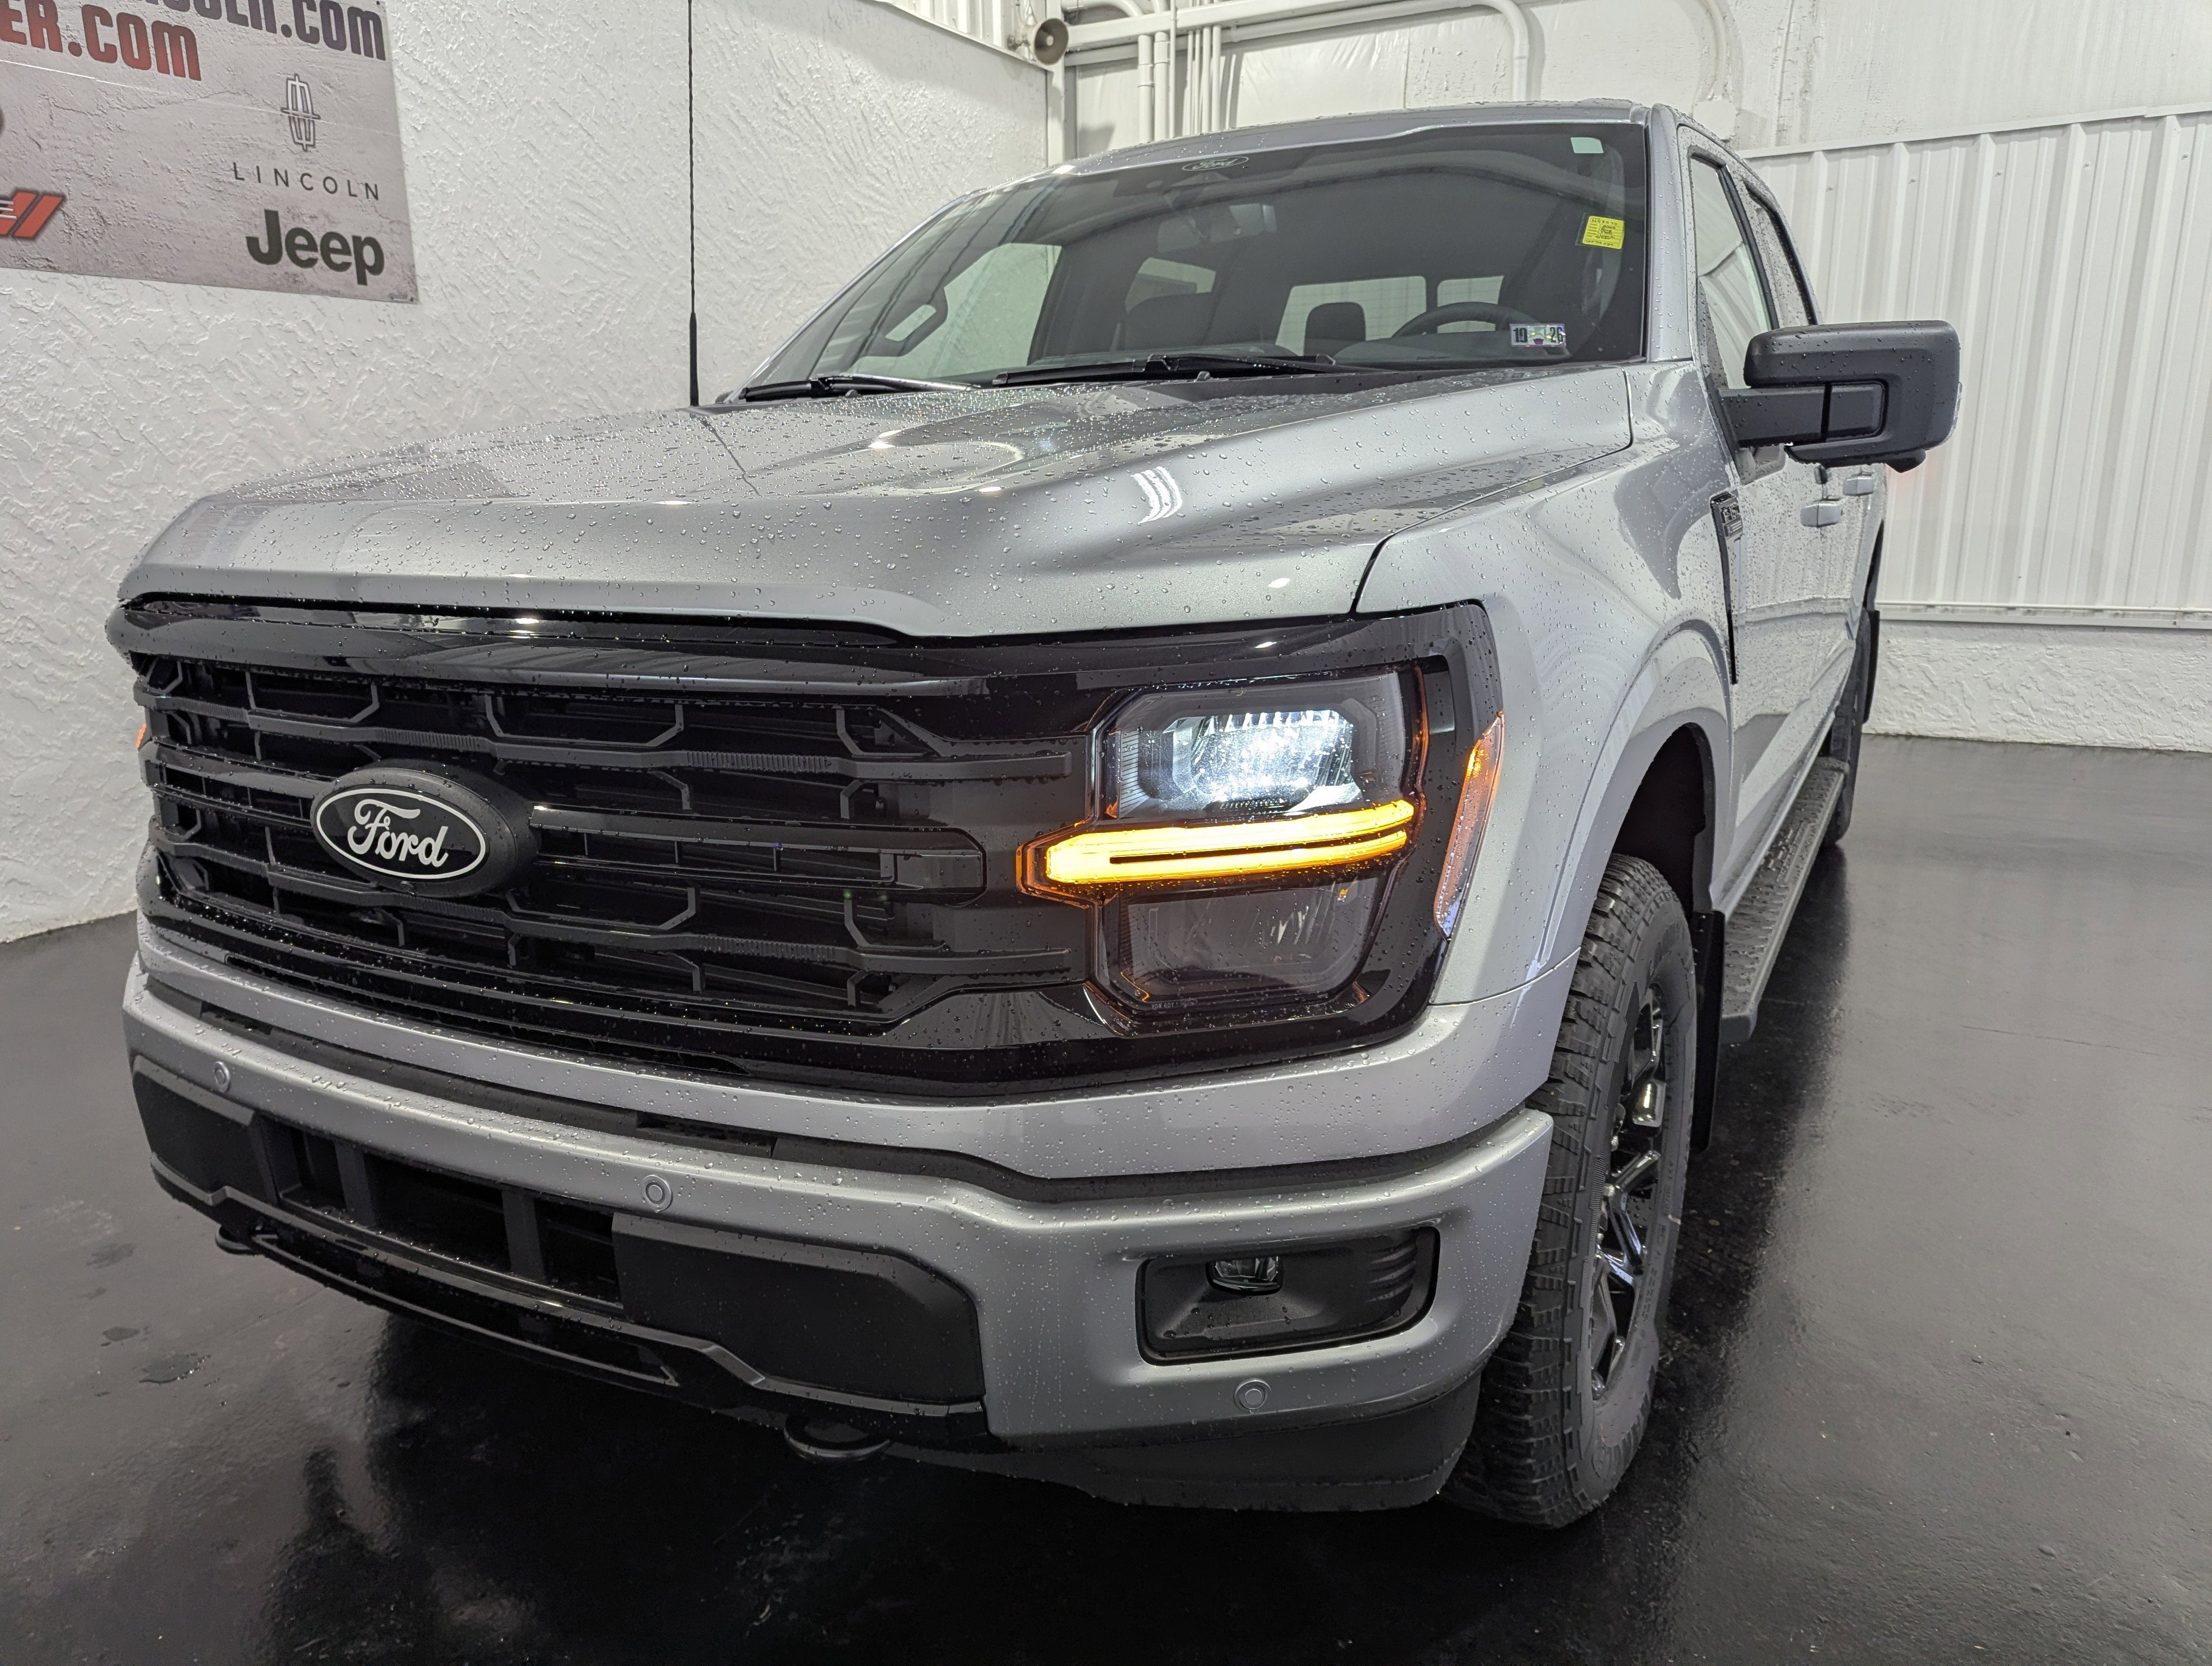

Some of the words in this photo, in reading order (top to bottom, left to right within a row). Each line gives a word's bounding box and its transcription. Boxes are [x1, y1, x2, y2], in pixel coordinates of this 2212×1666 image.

[233, 162, 379, 200] LINCOLN
[1192, 158, 1239, 170] Ford
[246, 209, 384, 286] Jeep
[1549, 326, 1564, 343] 26
[348, 799, 449, 867] Ford
